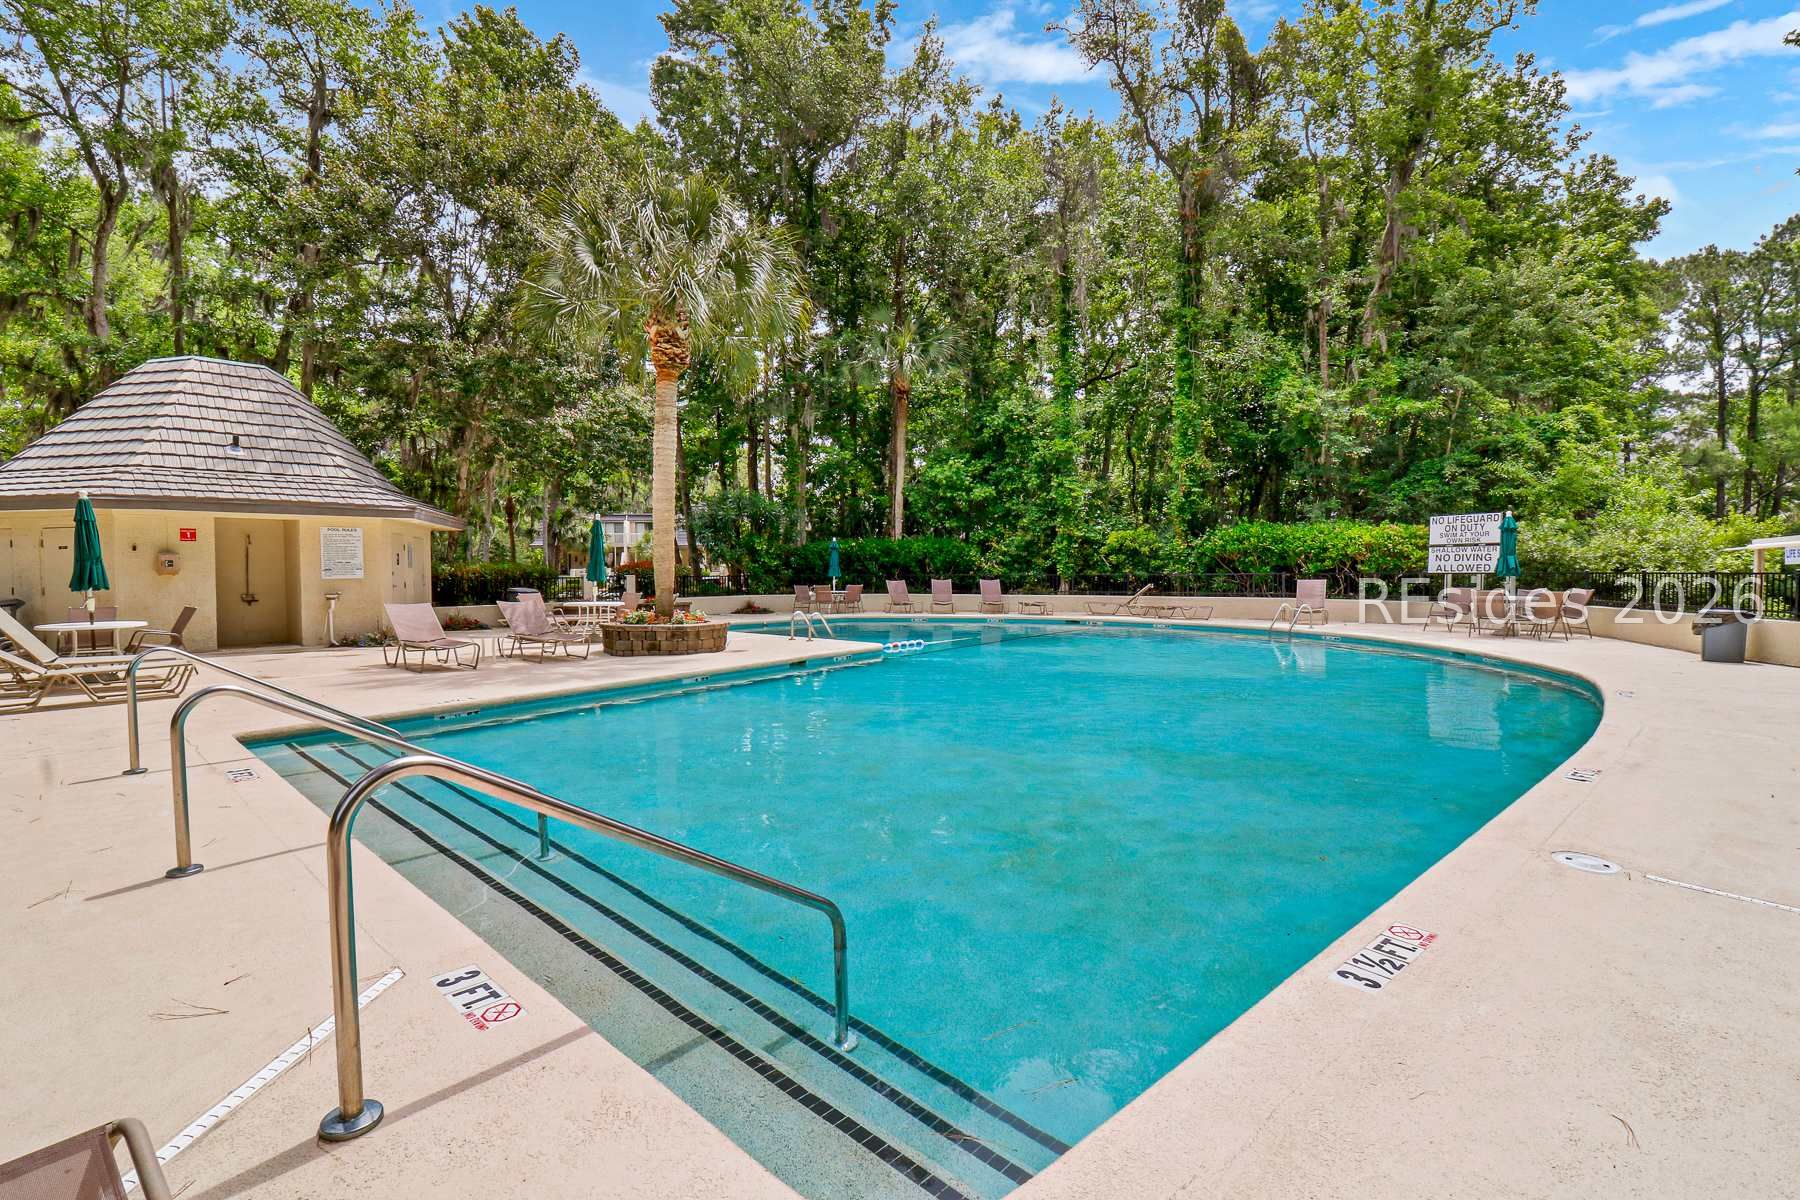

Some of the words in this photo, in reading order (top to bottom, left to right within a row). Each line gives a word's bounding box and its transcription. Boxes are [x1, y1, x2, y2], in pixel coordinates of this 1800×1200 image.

[1431, 517, 1445, 525] NO
[1447, 514, 1500, 524] LIFEGUARD
[1444, 525, 1457, 533] ON
[1460, 523, 1485, 532] DUTY
[1435, 554, 1450, 562] NO
[1454, 553, 1492, 562] DIVING
[1436, 564, 1491, 572] ALLOWED
[436, 970, 481, 987] 3
[1336, 970, 1382, 989] 3
[451, 982, 502, 1010] FT.
